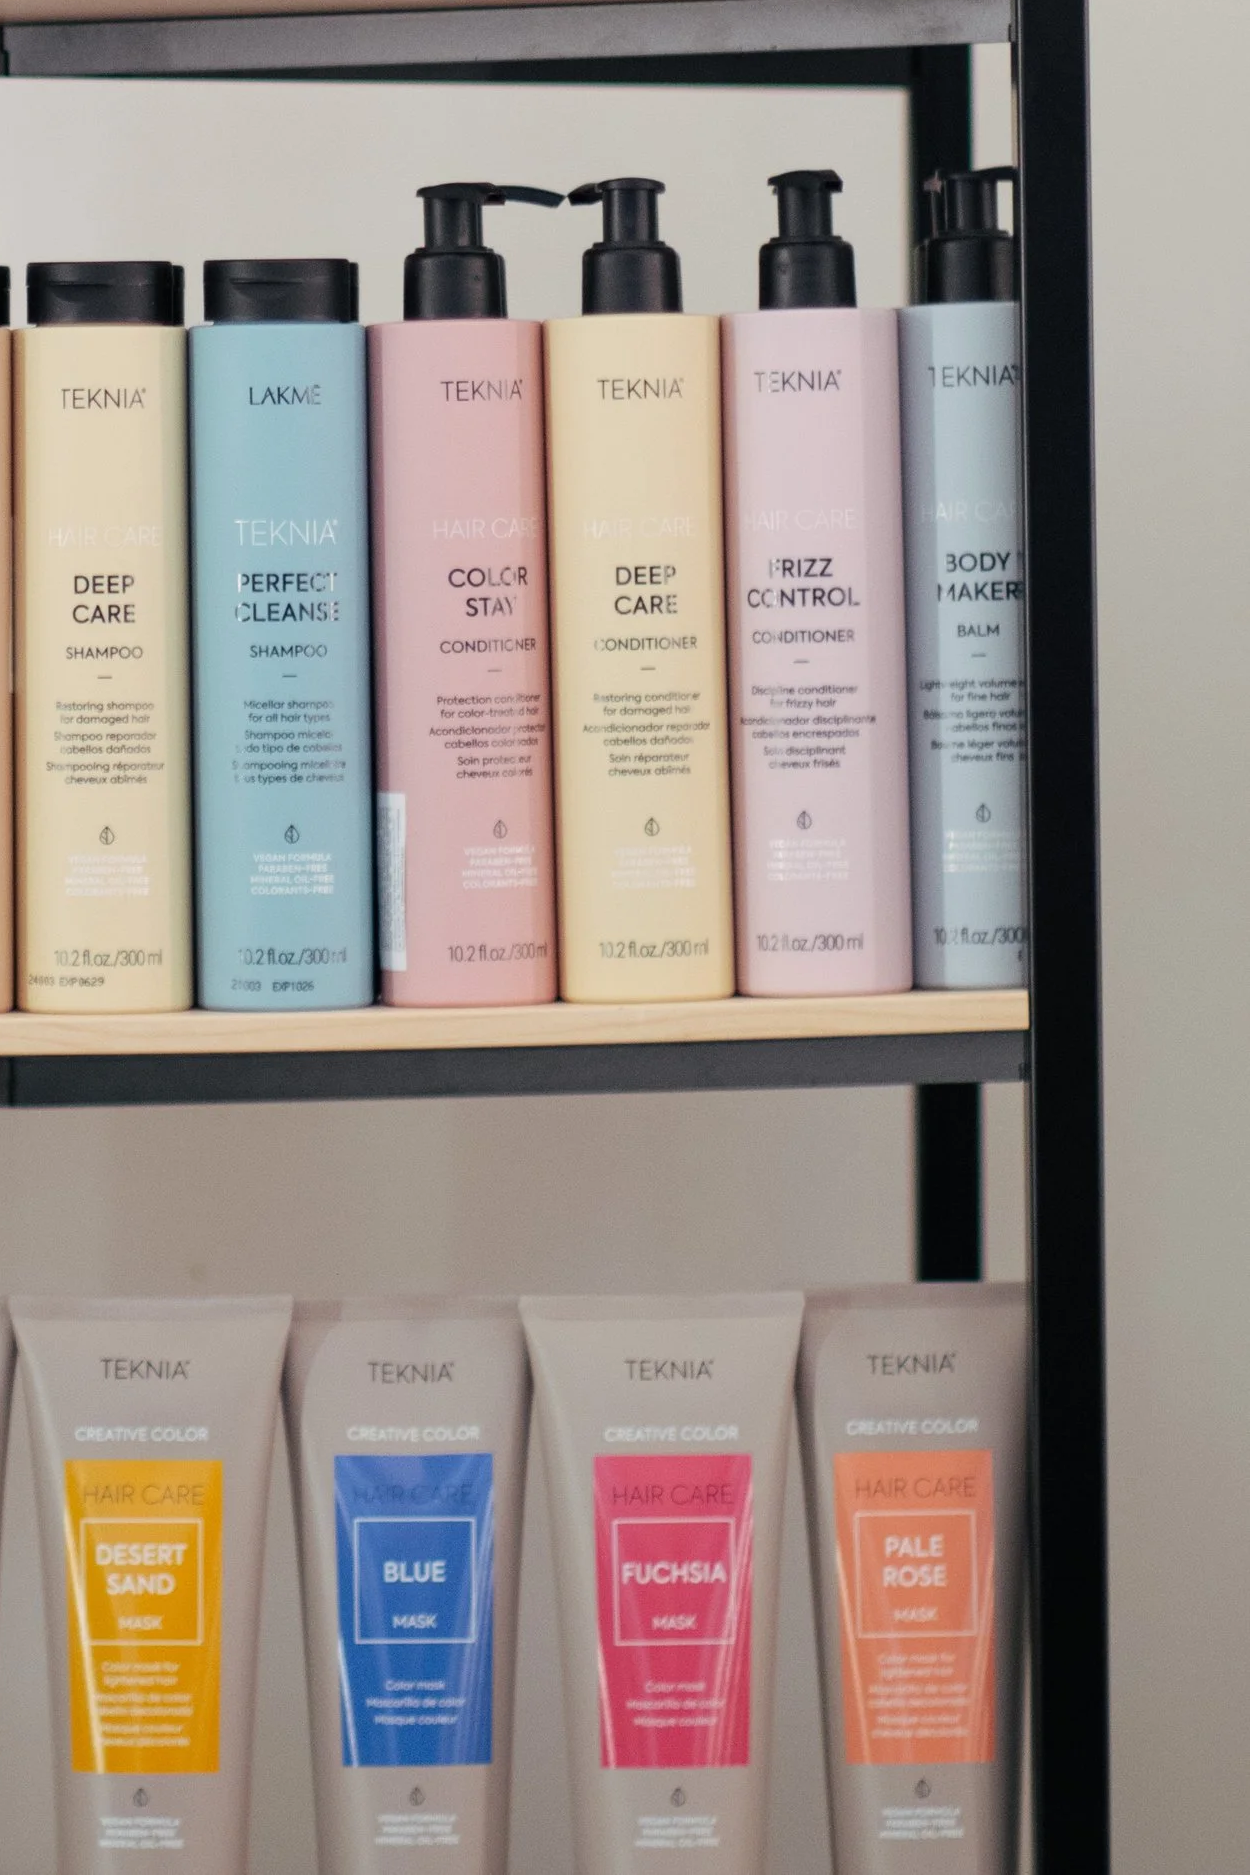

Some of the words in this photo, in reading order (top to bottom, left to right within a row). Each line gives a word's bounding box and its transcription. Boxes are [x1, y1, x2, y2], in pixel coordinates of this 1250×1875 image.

[72, 573, 136, 597] DEEP
[71, 603, 137, 626] CARE
[956, 623, 1001, 639] BALM
[64, 645, 144, 662] SHAMPOO
[94, 1543, 187, 1567] DESERT
[883, 1535, 944, 1559] PALE
[105, 1571, 176, 1596] SAND
[382, 1560, 447, 1584] BLUE
[621, 1561, 727, 1586] FUCHSIA
[881, 1564, 948, 1588] ROSE
[117, 1615, 162, 1632] MASK
[391, 1614, 437, 1630] MASK
[651, 1614, 697, 1631] MASK
